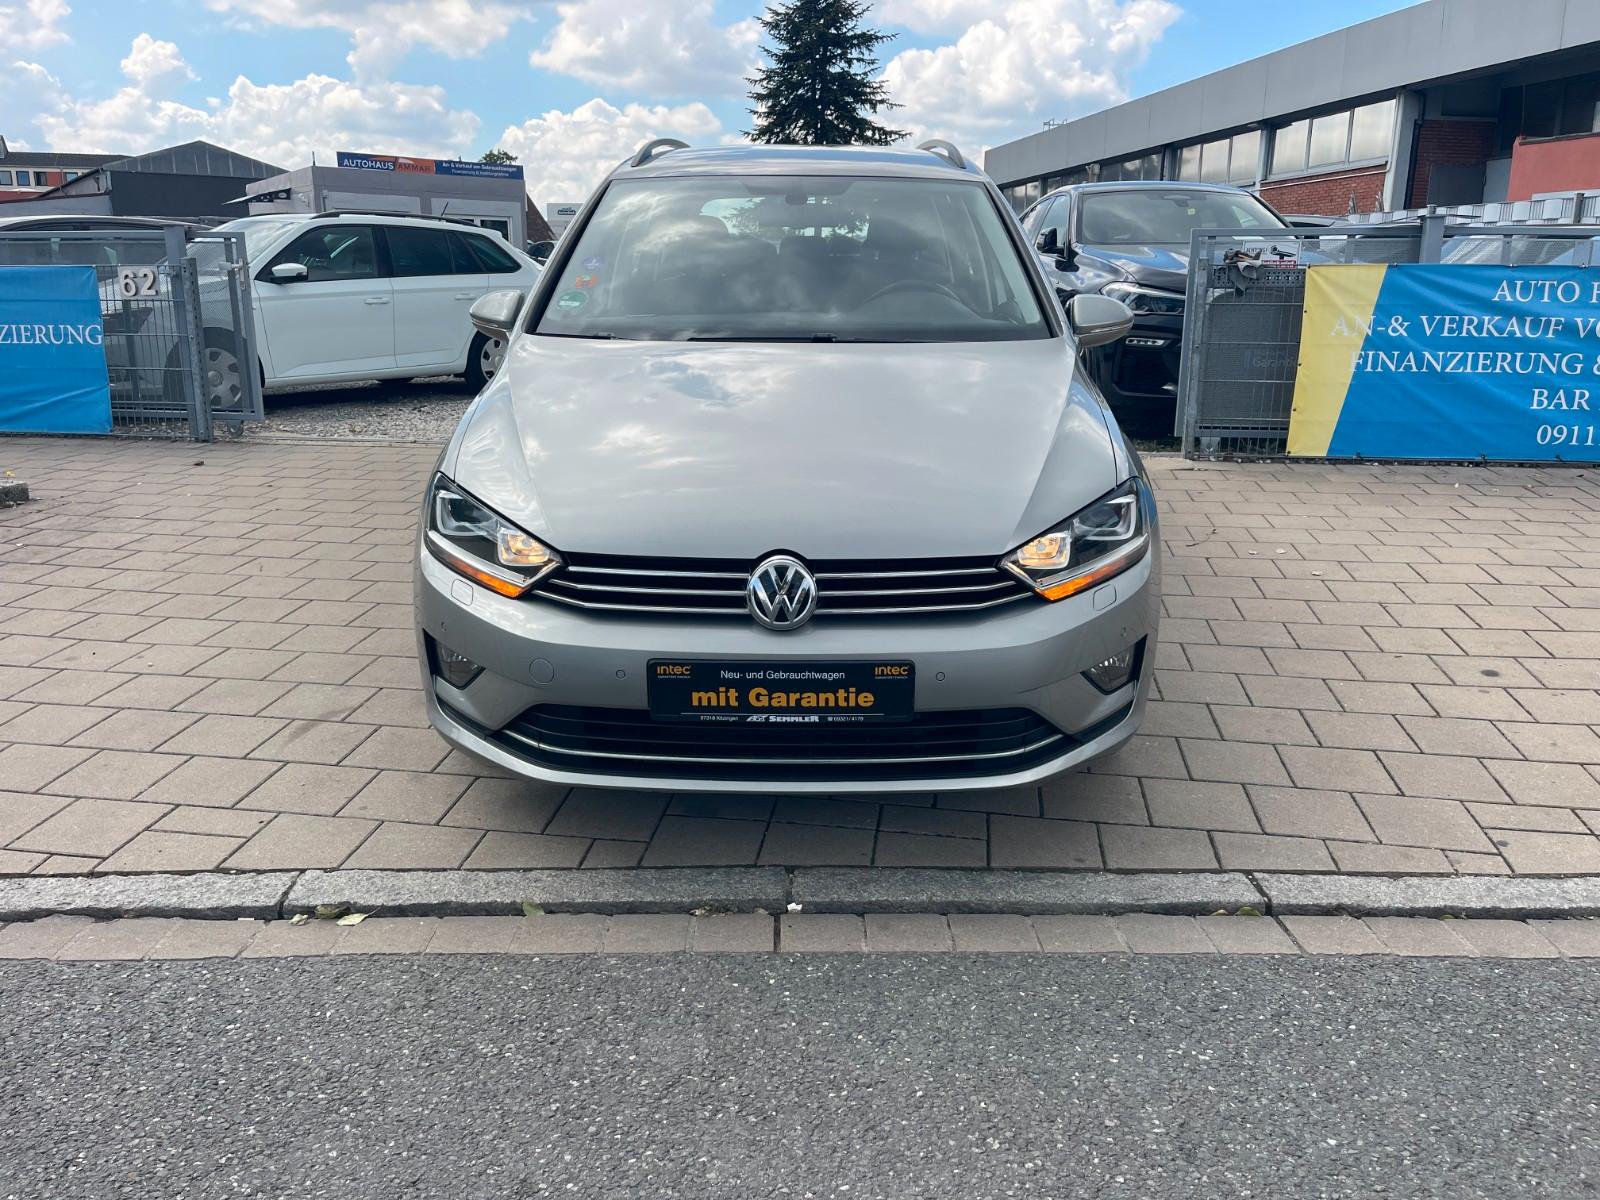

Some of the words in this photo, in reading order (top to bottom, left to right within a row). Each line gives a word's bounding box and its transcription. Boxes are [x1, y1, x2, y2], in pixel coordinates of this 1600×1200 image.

[343, 158, 394, 170] AUTOHAUS
[119, 268, 158, 298] 62
[1491, 280, 1580, 304] AUTO
[1419, 315, 1565, 339] VERKAUF
[1350, 351, 1584, 375] FINANZIERUNG
[1530, 388, 1590, 411] BAR
[657, 665, 691, 675] intec
[720, 670, 743, 679] Neu-
[745, 670, 764, 679] und
[766, 670, 845, 681] Gebrauchtwagen
[874, 665, 909, 675] intec
[692, 687, 739, 707] mit
[748, 687, 875, 707] Garantie
